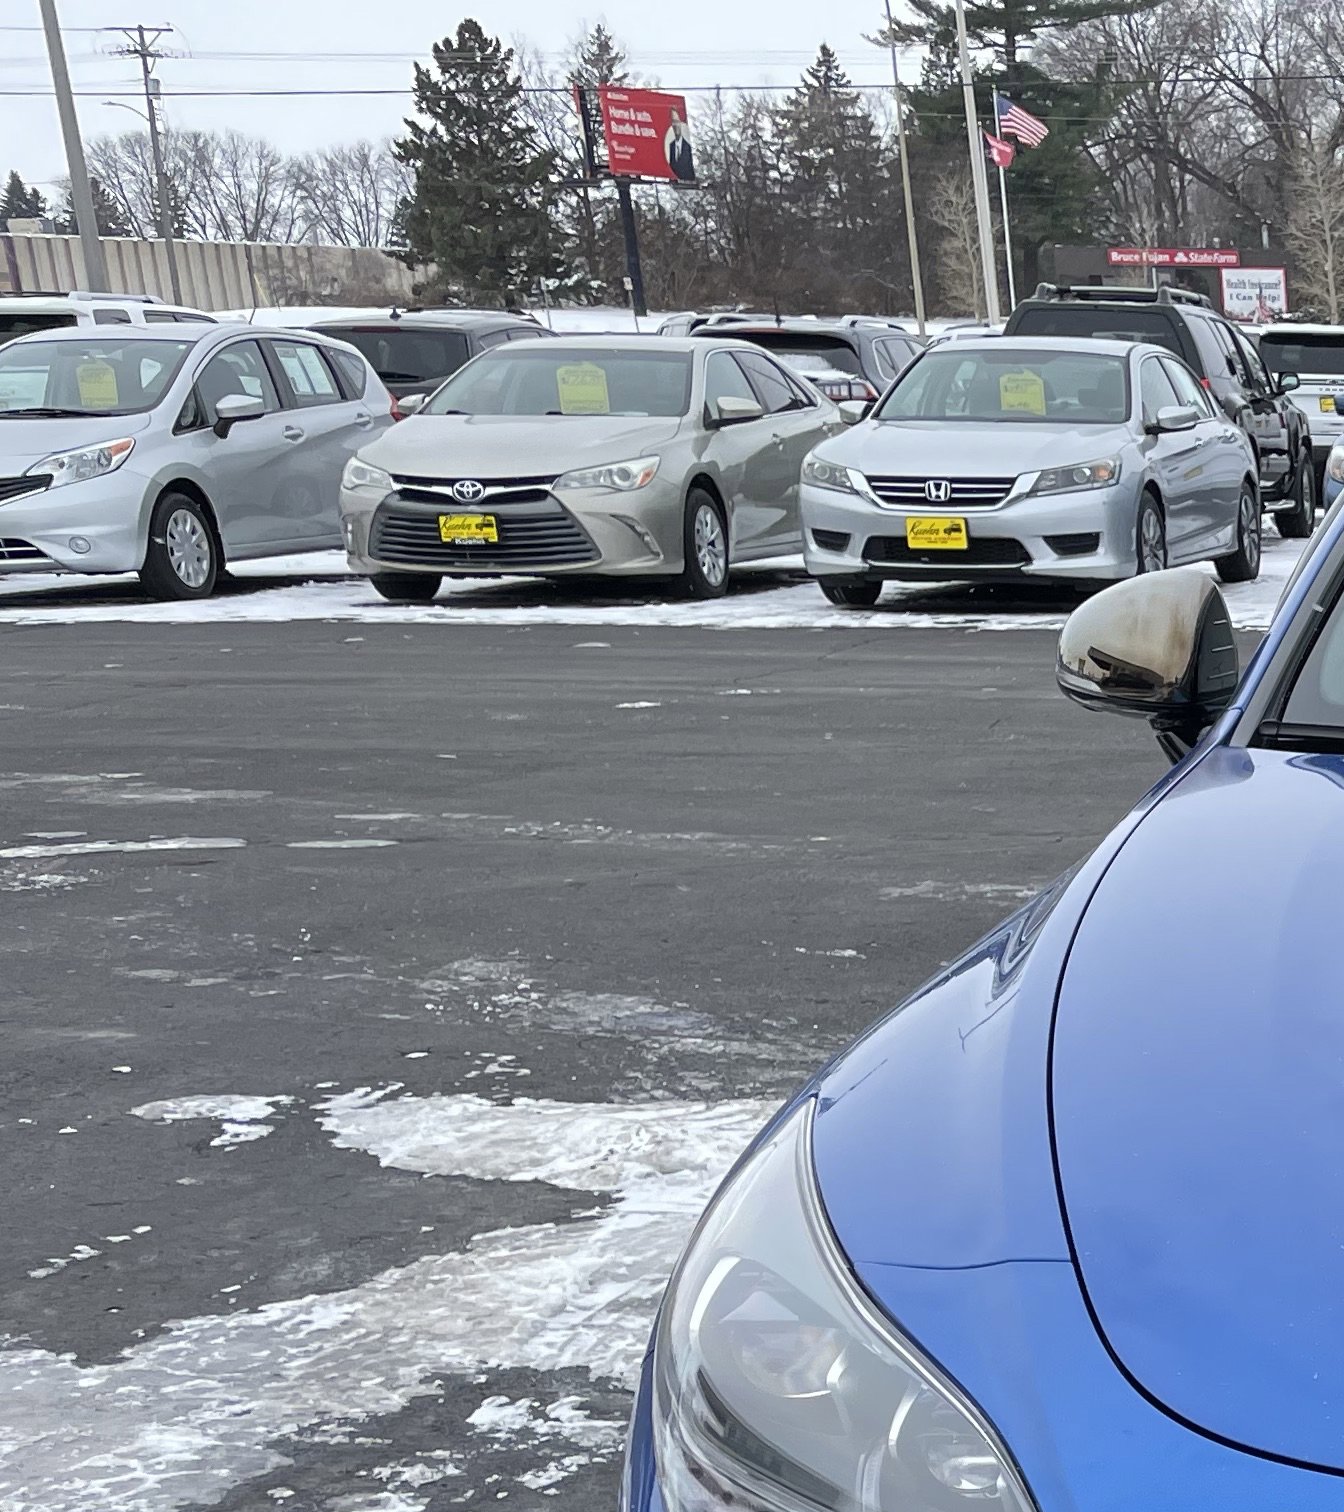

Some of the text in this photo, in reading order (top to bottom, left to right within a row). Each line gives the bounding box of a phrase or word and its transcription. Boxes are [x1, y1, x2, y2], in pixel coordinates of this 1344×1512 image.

[1111, 251, 1140, 262] Bruce
[1225, 279, 1247, 289] Health
[1235, 292, 1253, 301] Can
